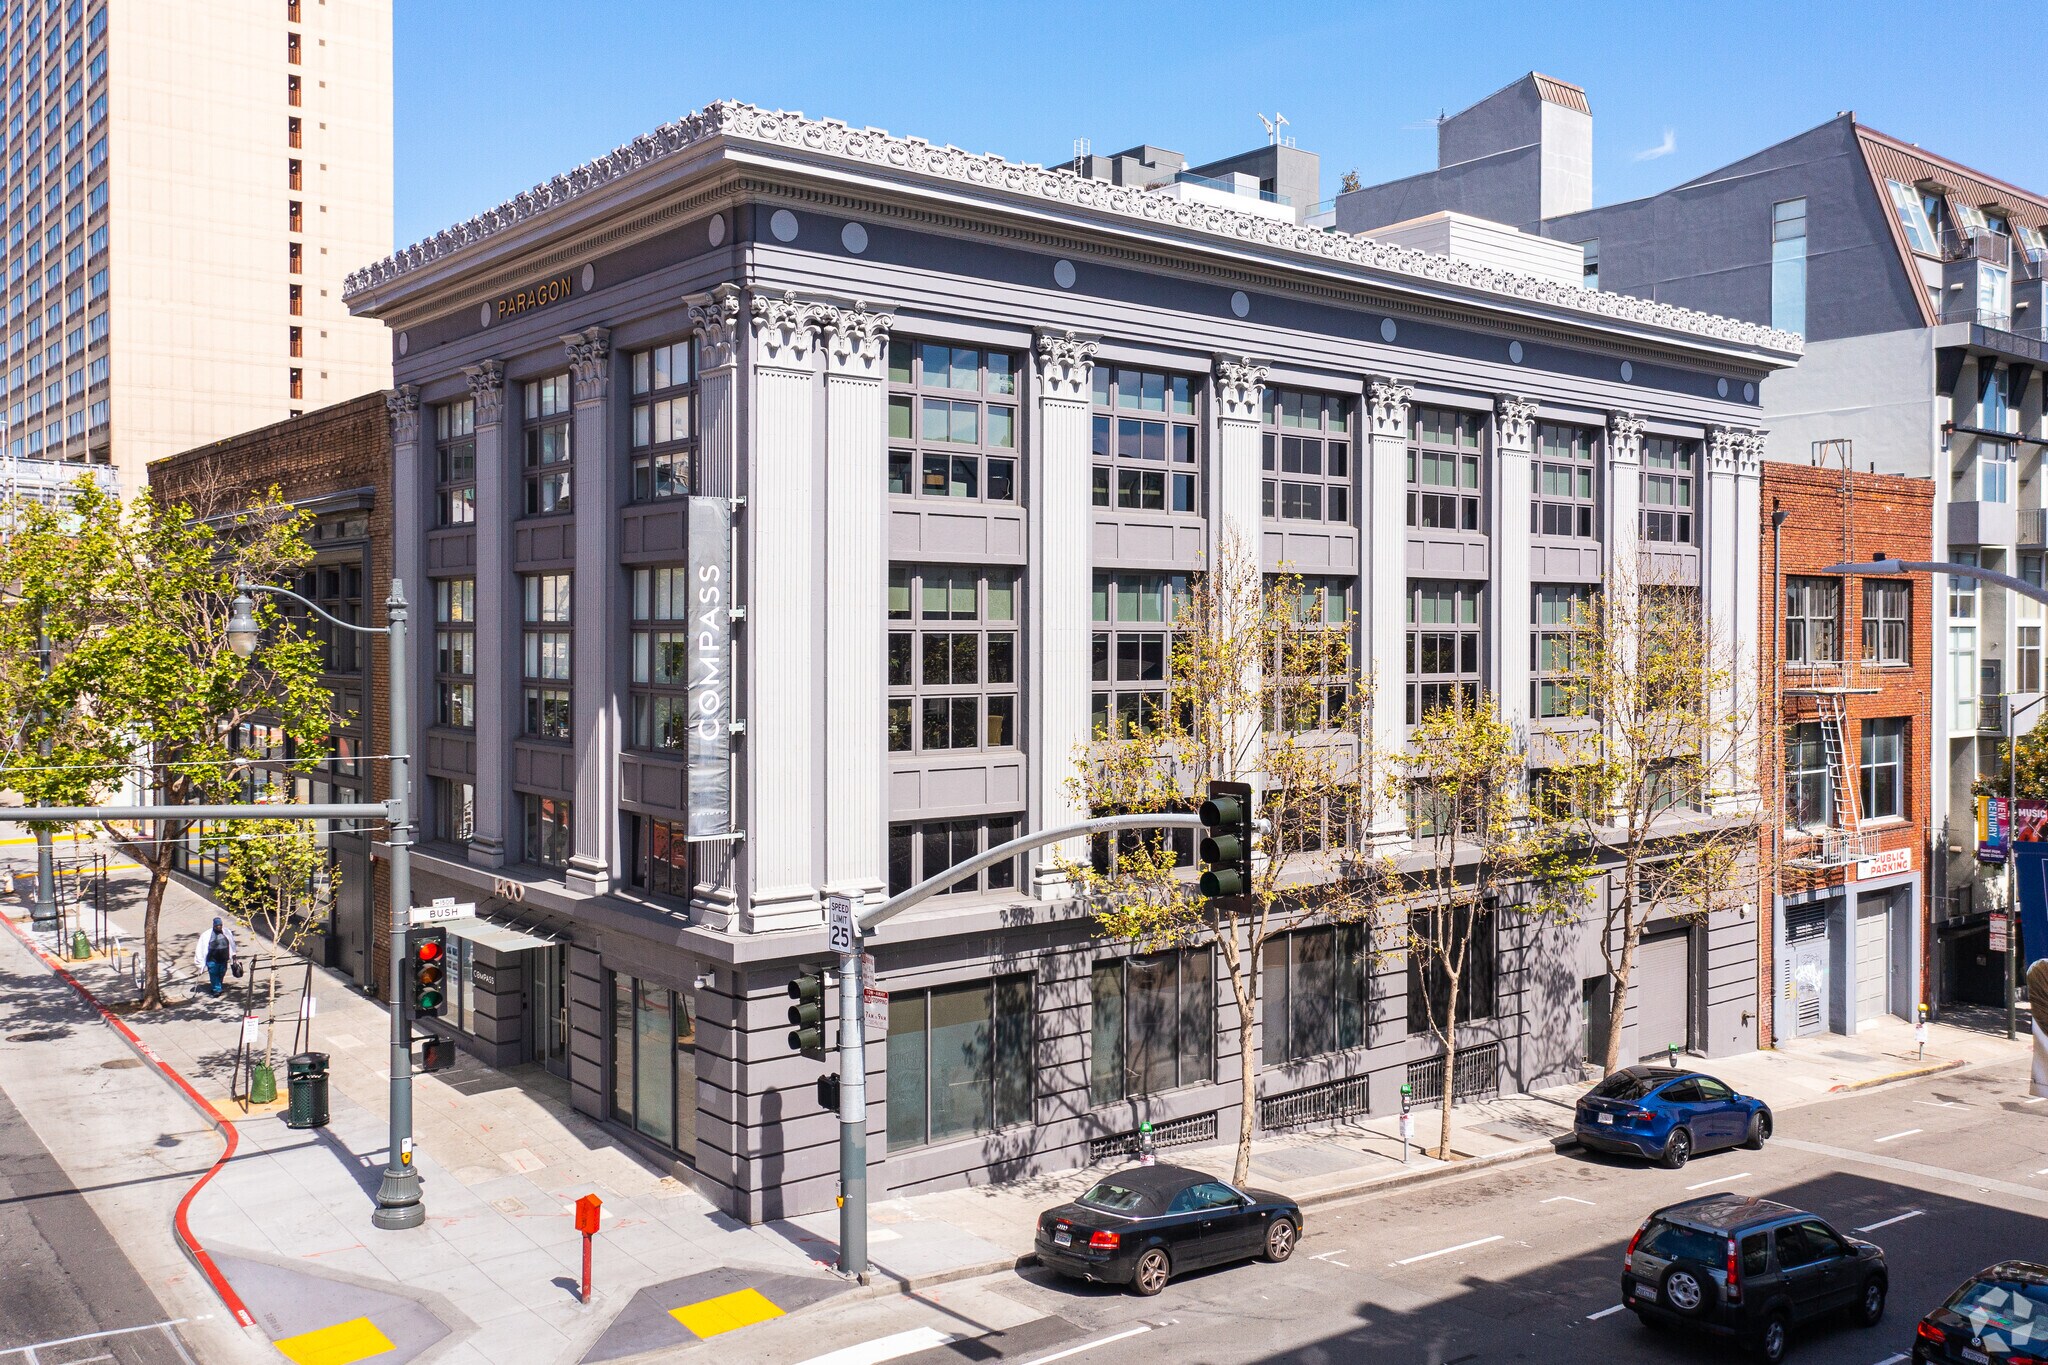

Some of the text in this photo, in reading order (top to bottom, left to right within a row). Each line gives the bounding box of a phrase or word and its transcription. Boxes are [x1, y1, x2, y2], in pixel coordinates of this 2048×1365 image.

[498, 275, 572, 319] PARAGON
[698, 564, 721, 741] COMPASS
[1997, 801, 2007, 820] NEW
[2018, 808, 2047, 819] MUSIC
[1988, 801, 1998, 838] CENTURY
[1874, 851, 1904, 864] PUBLIC
[1870, 860, 1908, 875] PARKING
[494, 877, 525, 902] 1400
[439, 898, 454, 906] 1500
[831, 902, 849, 913] SPEED
[429, 908, 458, 919] BUSH
[833, 914, 848, 924] LIMIT
[831, 925, 849, 947] 25
[473, 969, 495, 985] COMPASS
